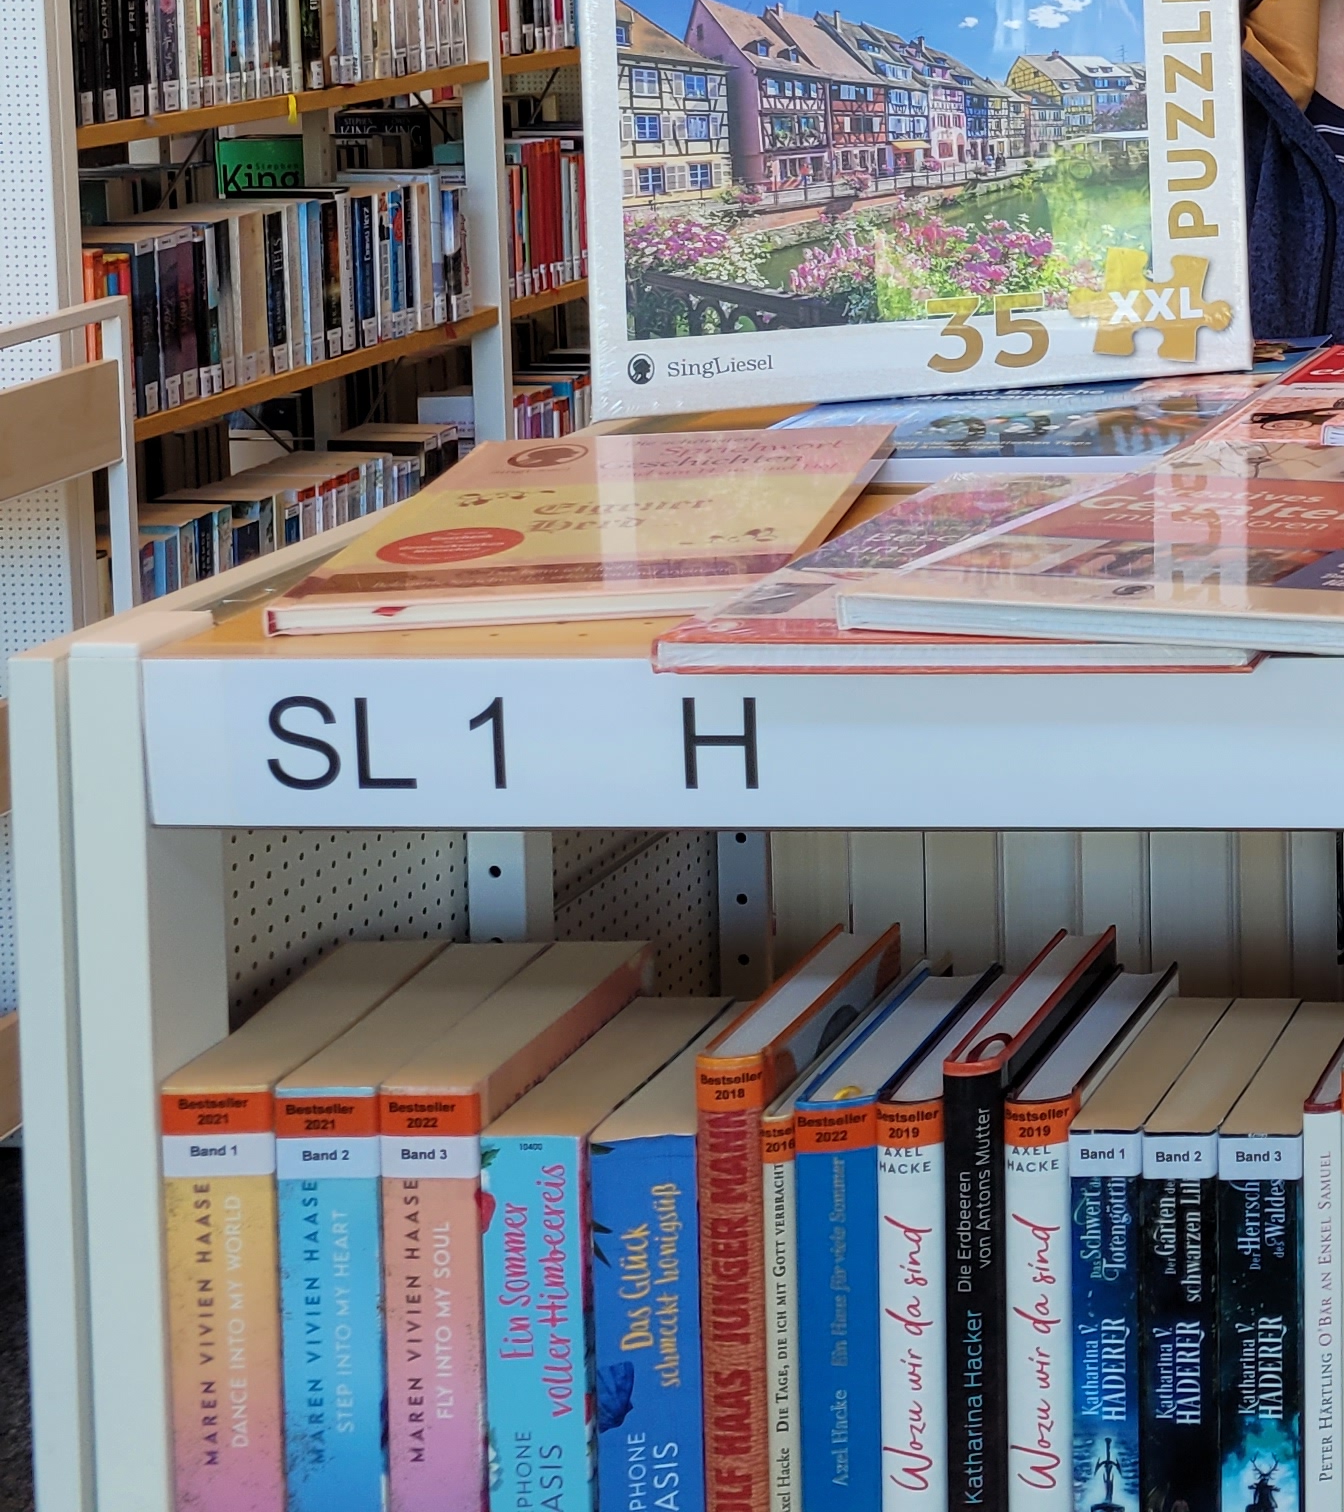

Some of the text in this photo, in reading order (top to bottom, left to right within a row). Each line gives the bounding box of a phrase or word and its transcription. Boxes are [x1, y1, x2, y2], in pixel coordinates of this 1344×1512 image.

[926, 292, 1049, 373] 35
[1108, 286, 1204, 325] XXL
[667, 355, 774, 380] SingLiesel
[266, 695, 759, 790] SL 1 H
[178, 1097, 249, 1126] Bestseller 2021
[190, 1144, 238, 1157] Band 1
[956, 1170, 971, 1293] Die Erdbeeren
[974, 1107, 992, 1269] von Antons Mutter
[192, 1182, 219, 1467] MAREN VIVIEN HAASE
[500, 1203, 532, 1361] Ein Sommer
[535, 1163, 573, 1419] voller Himbeereis
[961, 1310, 984, 1505] Katharina Hacker
[1103, 1317, 1128, 1422] HADERER
